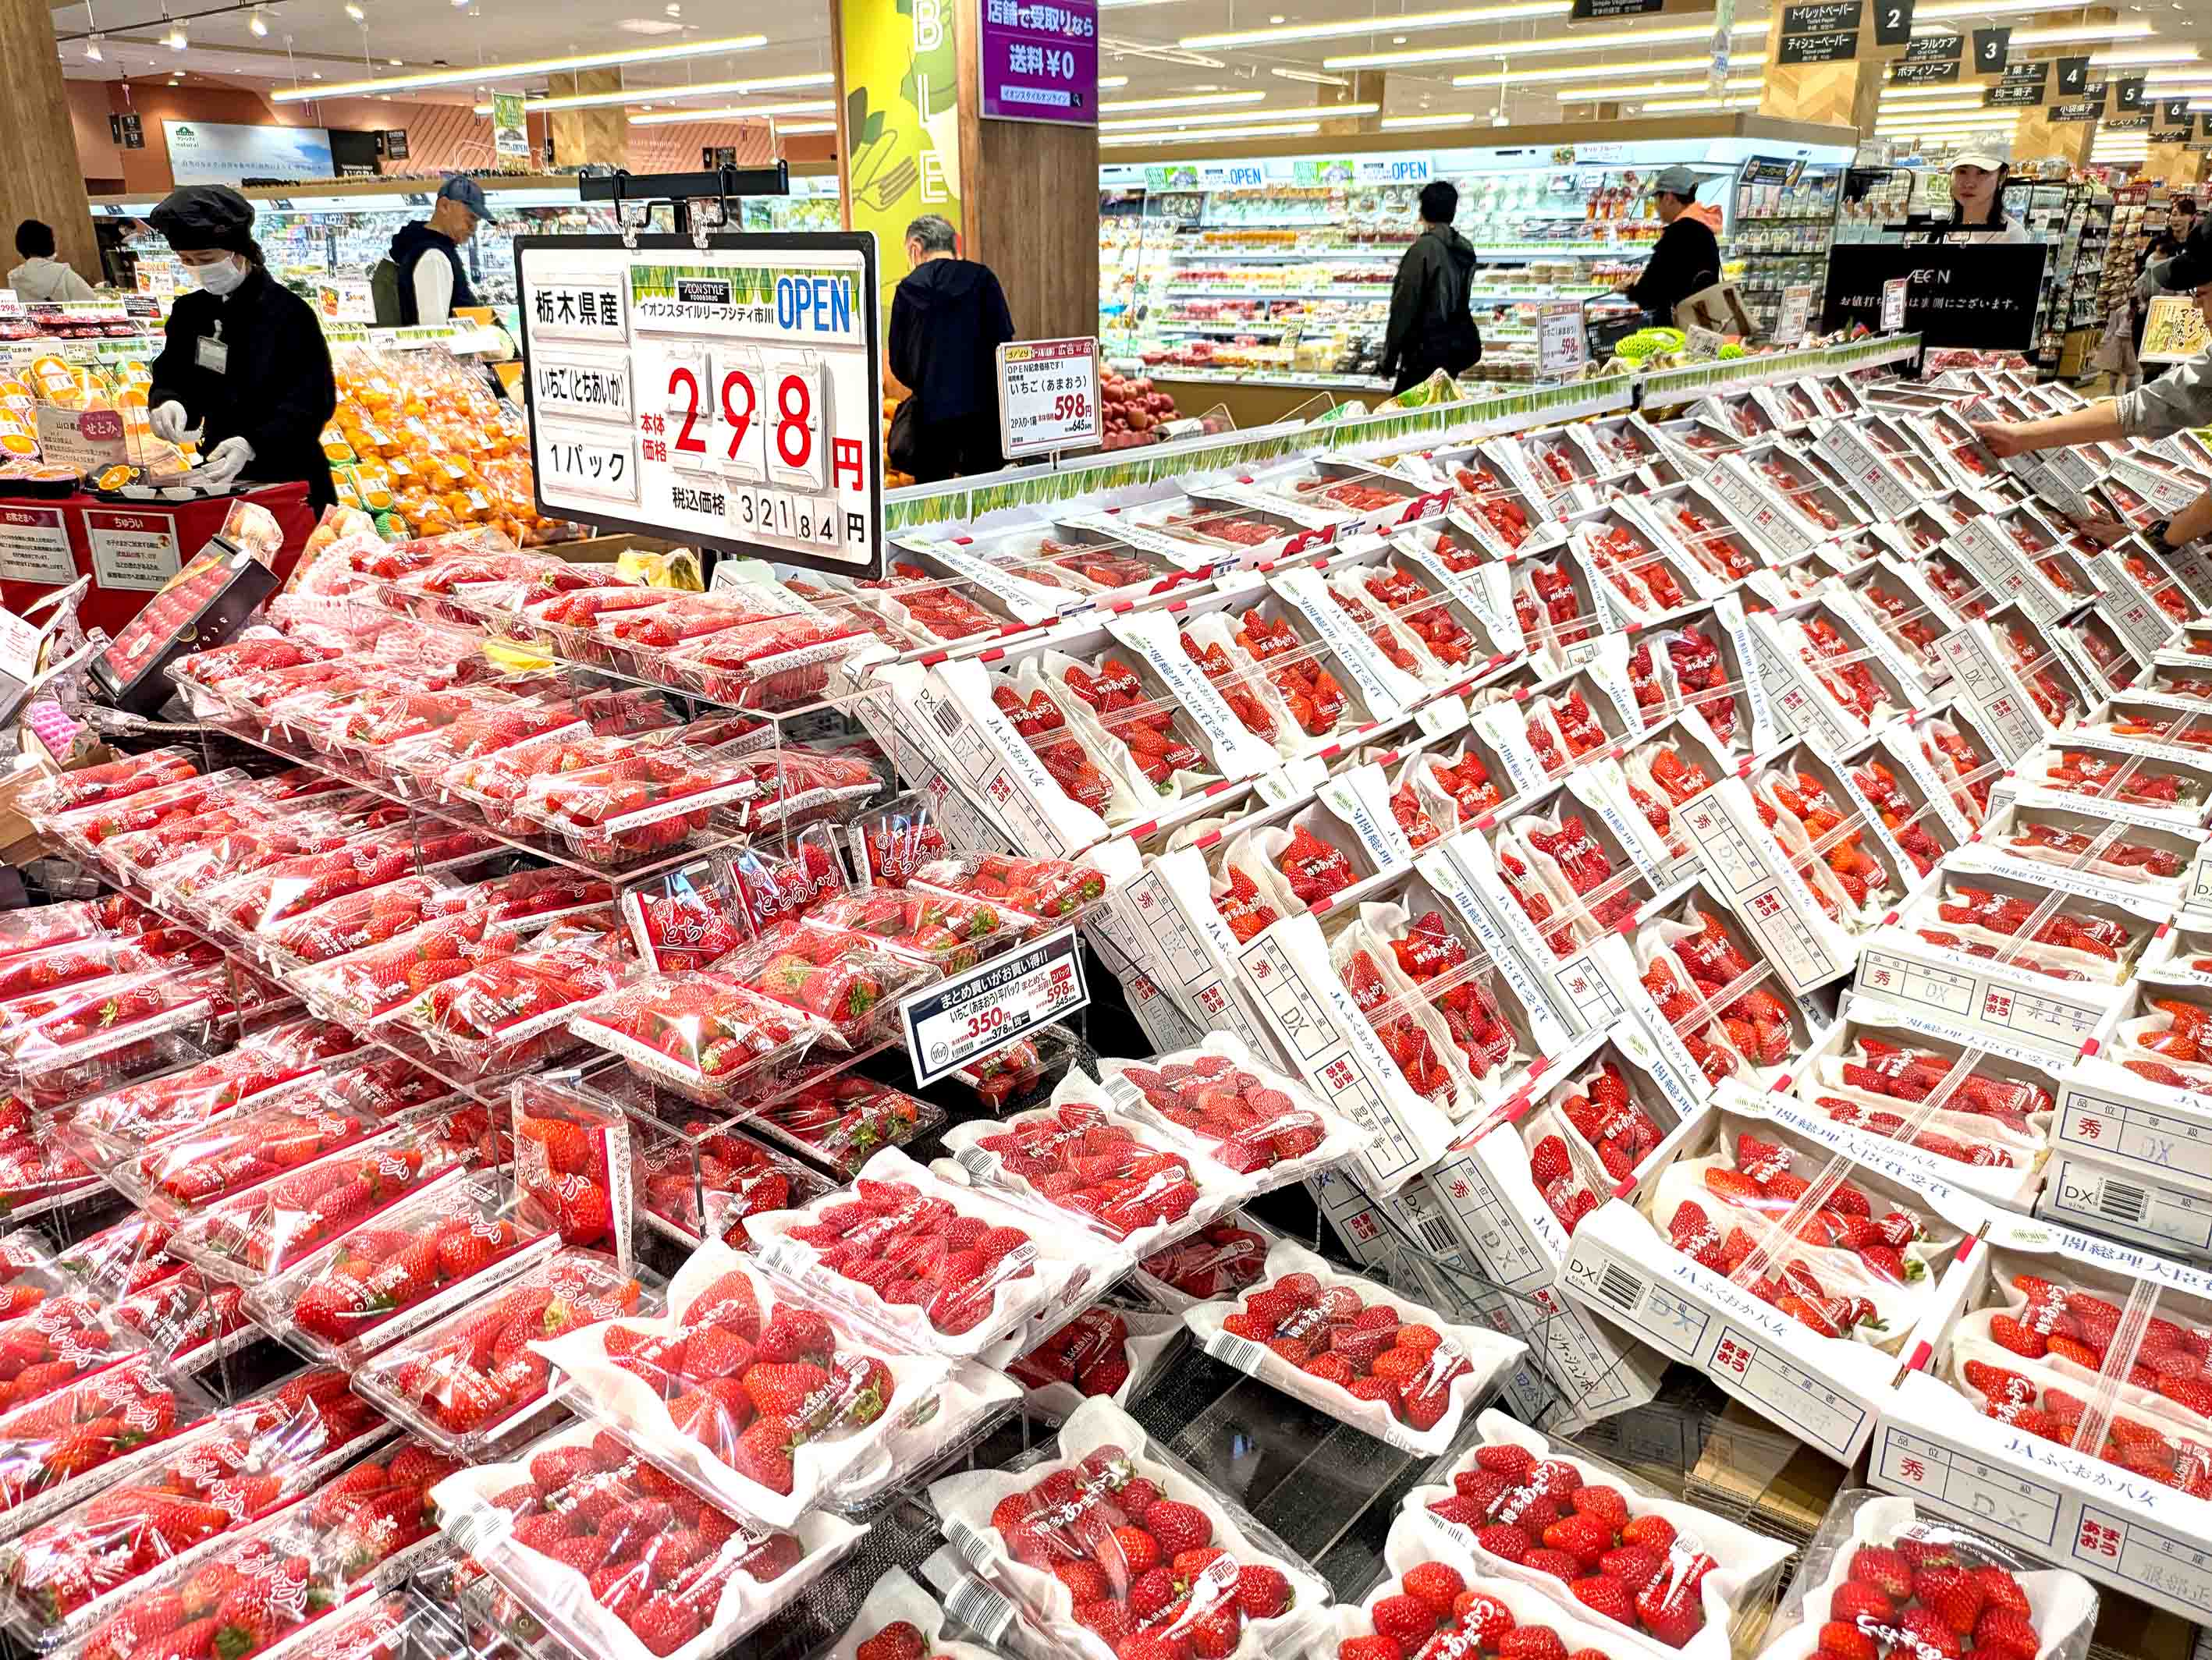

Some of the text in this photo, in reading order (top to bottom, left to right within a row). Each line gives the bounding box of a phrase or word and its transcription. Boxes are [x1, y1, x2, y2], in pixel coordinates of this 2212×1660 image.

[987, 0, 1093, 37] 店舗で受取りなら
[1792, 5, 1855, 20] トイレットペーパー
[1887, 9, 1901, 28] 2
[1788, 36, 1849, 50] ティシューペーパー
[1985, 42, 1997, 60] 3
[1898, 63, 1953, 77] ボディソープ
[2067, 69, 2078, 83] 4
[2125, 88, 2136, 101] 5
[2171, 104, 2180, 115] 6
[1230, 168, 1262, 186] OPEN
[1392, 161, 1428, 180] OPEN
[703, 284, 724, 296] STYLE
[535, 289, 619, 327] 栃木県産
[641, 303, 774, 325] イオンスタイルリーフシティ市川
[778, 278, 850, 333] OPEN
[1841, 296, 2020, 311] お値打ちは裏側にございます。
[539, 368, 623, 407] いちご(とちあいか)
[1010, 375, 1087, 395] いちご（あまおう）
[87, 421, 118, 435] せとみ
[640, 413, 665, 435] 本体
[641, 438, 667, 462] 価格
[551, 445, 624, 482] 1パック
[673, 487, 726, 516] 税込価格
[1757, 662, 1772, 680] DX
[1965, 668, 1985, 687] DX
[921, 688, 937, 709] DX
[986, 718, 1045, 788] JAふくおか八女
[1693, 813, 1712, 830] 秀
[759, 864, 840, 917] とちあいか
[1137, 891, 1154, 909] 秀
[940, 949, 1049, 1009] まとめ買いがお買い得!!
[1051, 968, 1071, 981] 2パック
[1251, 959, 1273, 979] 秀
[1874, 969, 1891, 986] 秀
[1021, 971, 1046, 990] まとめて
[1570, 977, 1588, 995] 秀
[950, 981, 1021, 1023] いちご(あまおう)平パック
[1014, 1013, 1029, 1025] 均一
[1280, 1006, 1310, 1038] DX
[1330, 991, 1392, 1080] JAふくおか八女
[2076, 1098, 2115, 1117] 品位
[2078, 1116, 2102, 1140] 秀
[1449, 1178, 1471, 1199] 秀
[2065, 1185, 2093, 1205] DX
[1404, 1195, 1425, 1218] DX
[1569, 1258, 1597, 1283] DX
[1673, 1265, 1788, 1338] JAふくおか八女
[1288, 1289, 1344, 1339] 博多あまおう
[1778, 1364, 1836, 1405] 生産者
[1897, 1435, 1939, 1459] 品位
[1899, 1456, 1926, 1482] 秀
[2004, 1438, 2159, 1509] JAふくおか八女
[1030, 1470, 1120, 1536] 博多あまおう
[1499, 1460, 1560, 1525] 博多あまおう
